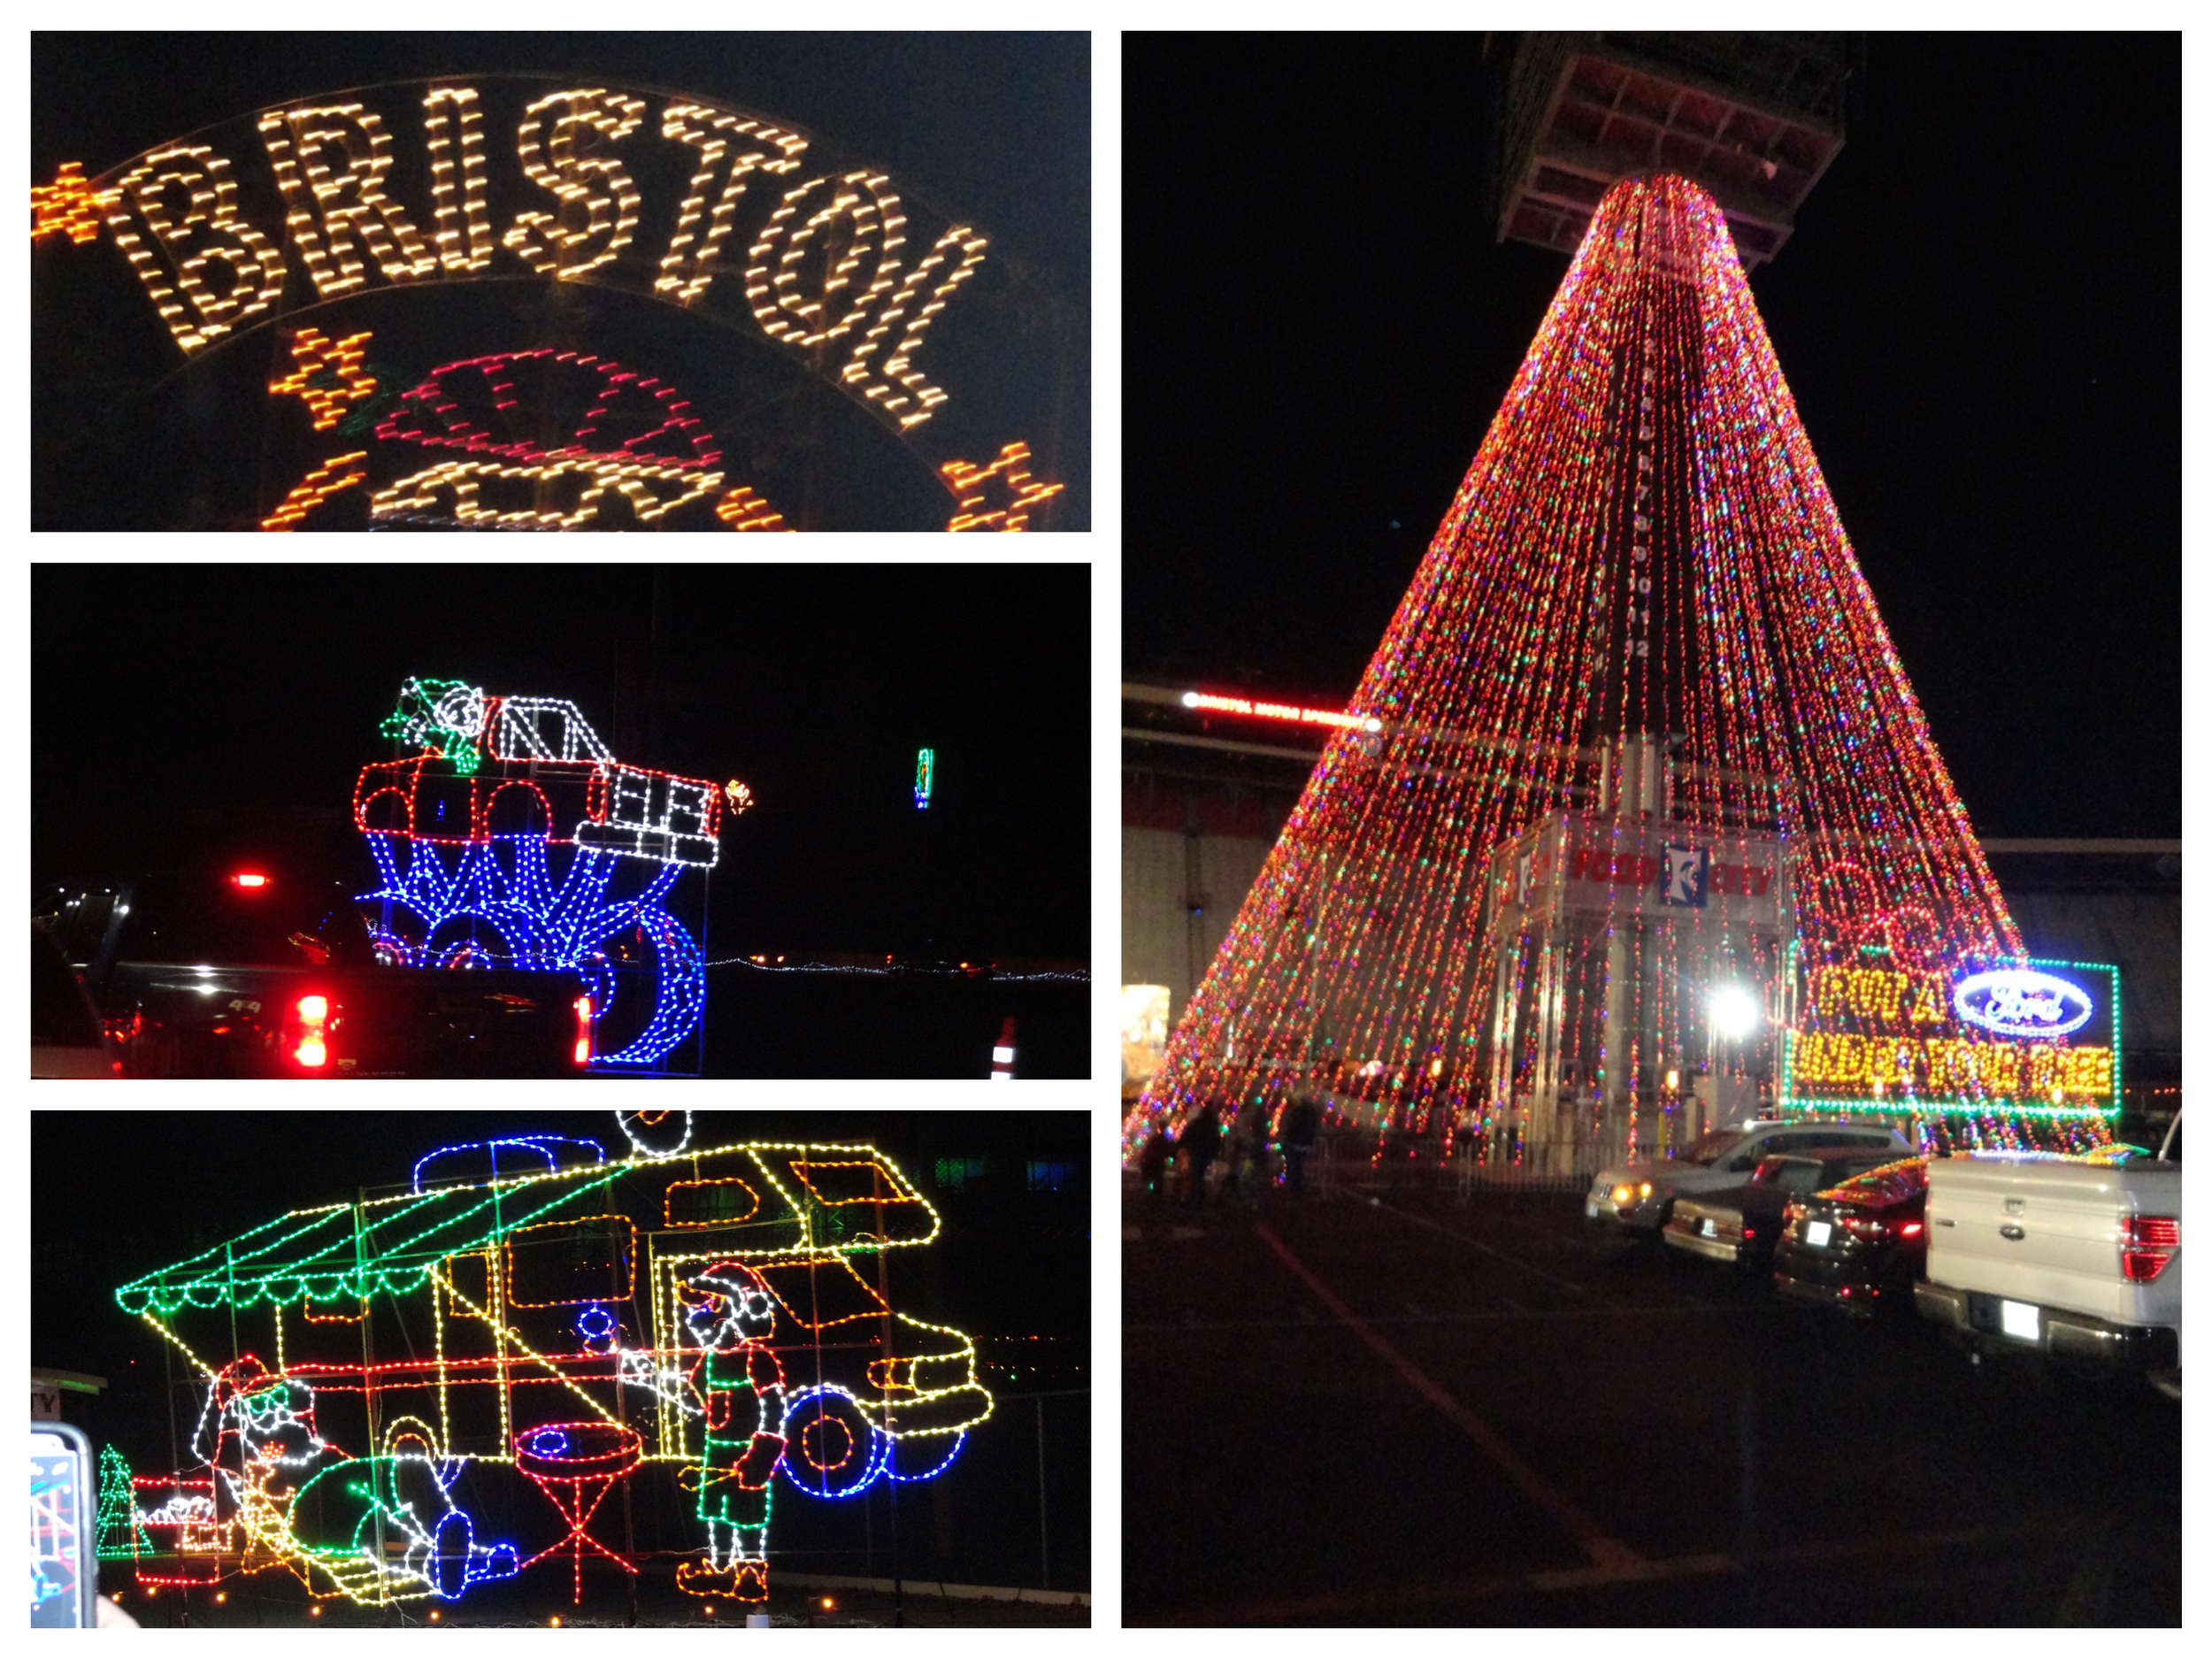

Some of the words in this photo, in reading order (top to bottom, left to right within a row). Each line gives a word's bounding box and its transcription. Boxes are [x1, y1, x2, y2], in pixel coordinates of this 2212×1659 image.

[97, 87, 991, 433] BRISTOL
[1639, 486, 1648, 501] 7
[1637, 515, 1648, 531] 8
[1634, 545, 1647, 562] 9
[1628, 639, 1649, 657] 12
[1910, 972, 1947, 1023] A
[1985, 979, 2064, 1024] Ford
